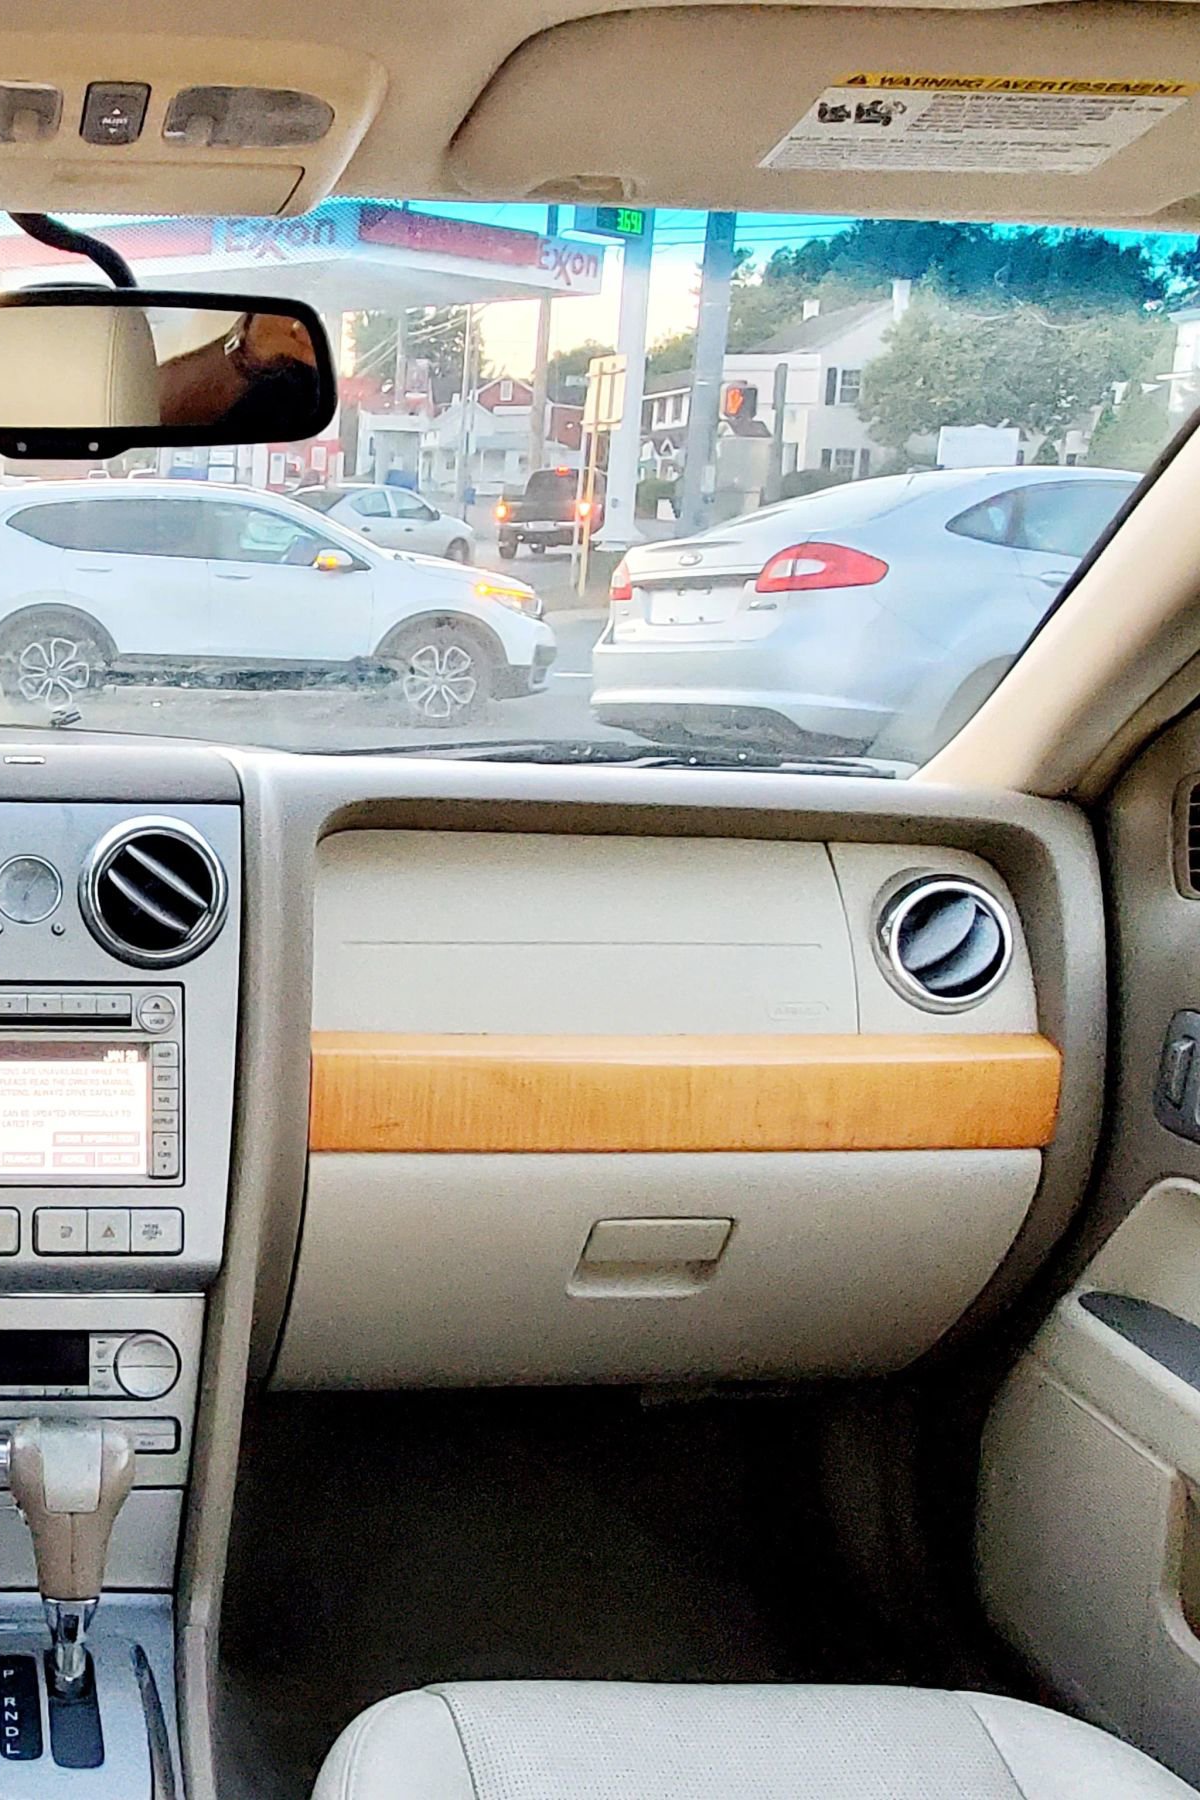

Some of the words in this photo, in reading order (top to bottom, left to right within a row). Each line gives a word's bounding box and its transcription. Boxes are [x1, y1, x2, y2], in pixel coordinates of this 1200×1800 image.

[3, 1669, 15, 1678] P
[4, 1697, 16, 1706] R
[5, 1712, 18, 1721] N
[5, 1726, 19, 1737] D
[6, 1743, 20, 1755] L
